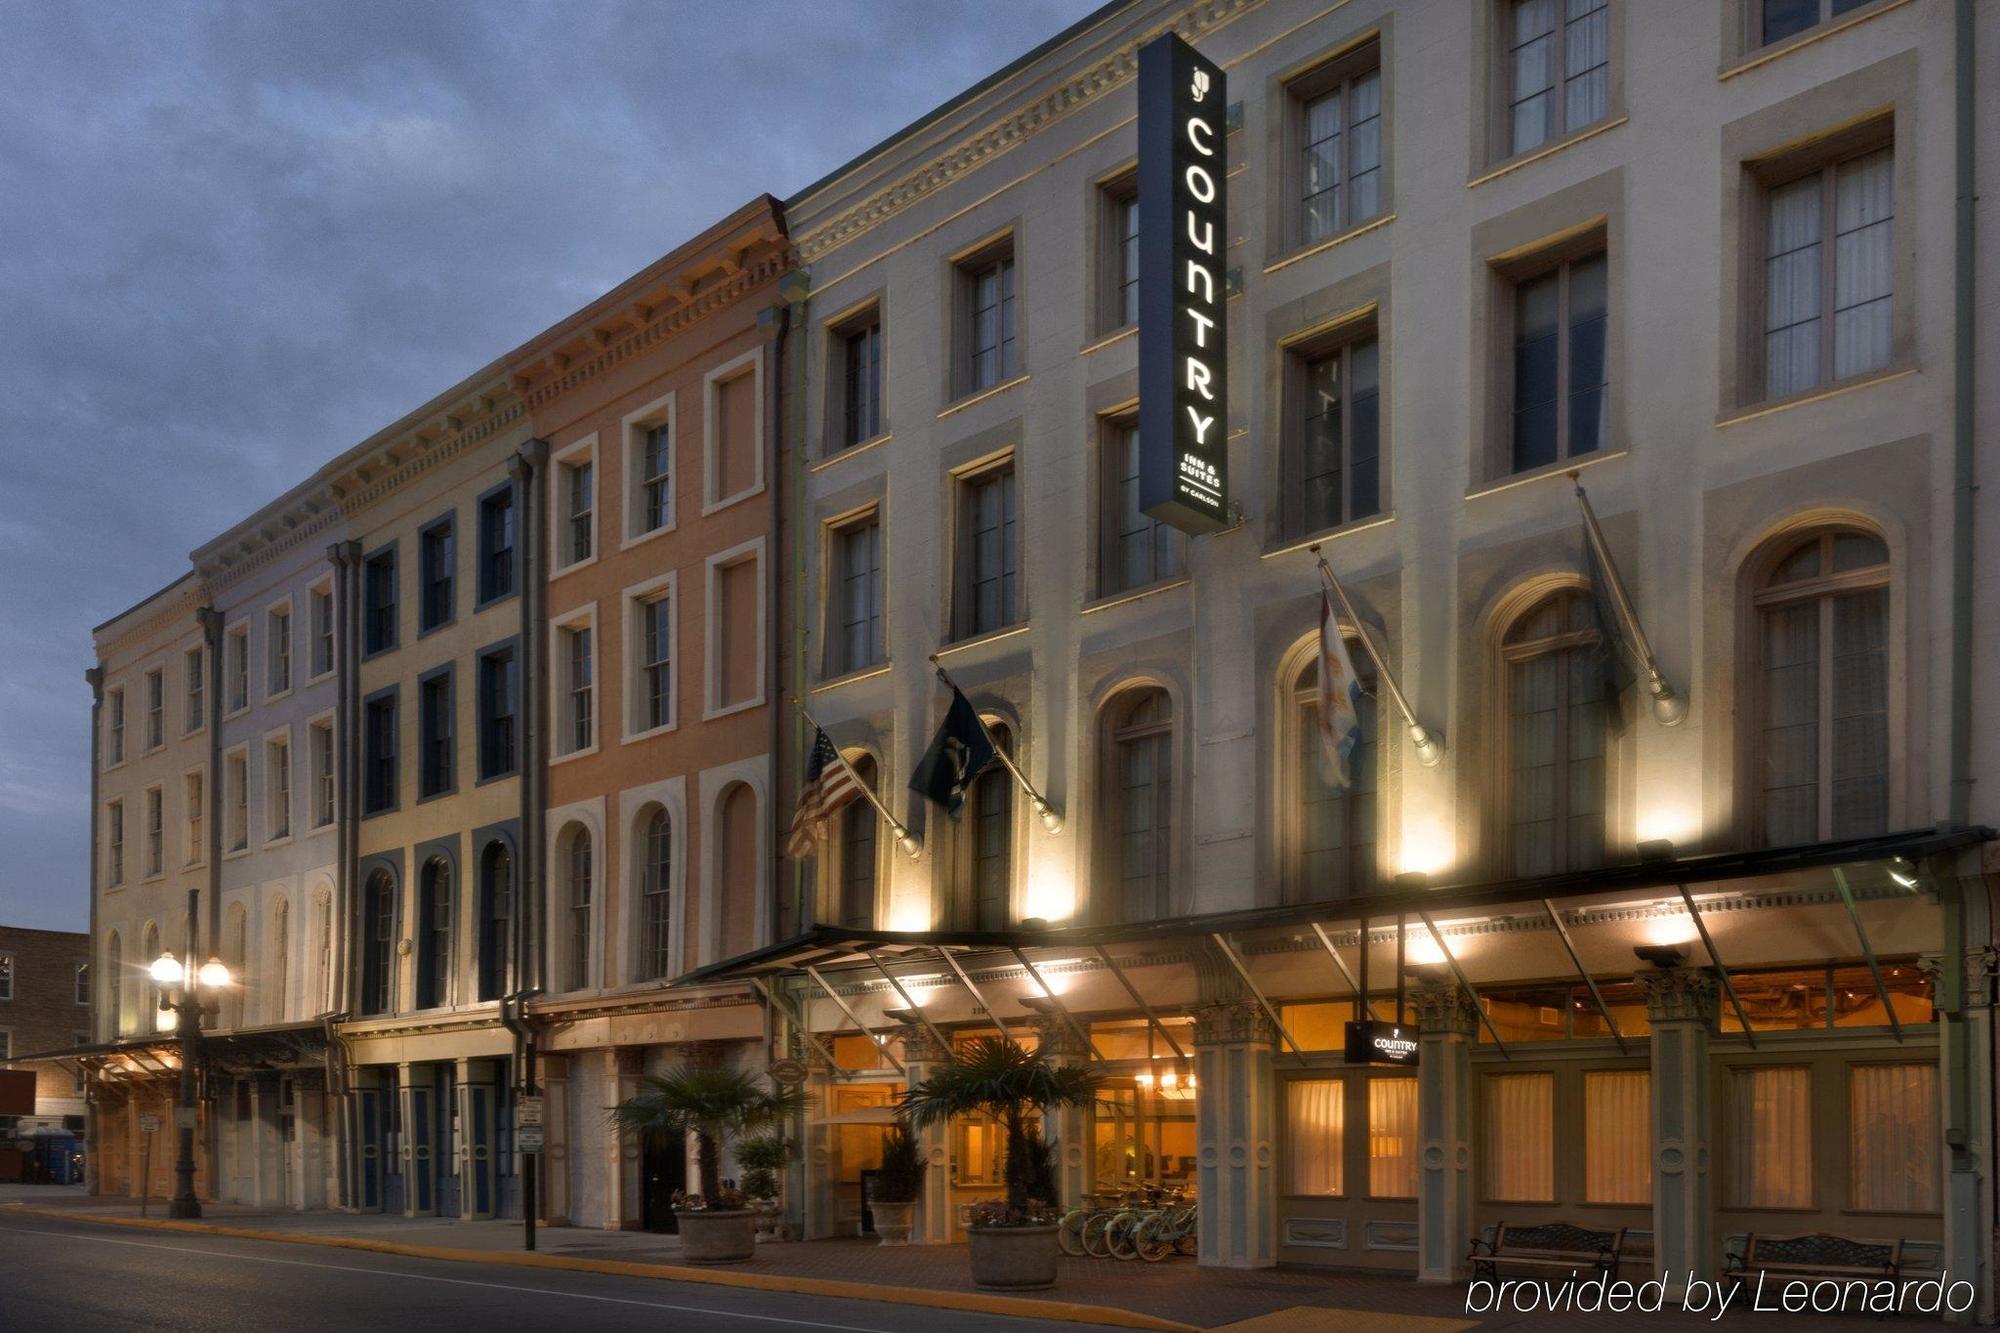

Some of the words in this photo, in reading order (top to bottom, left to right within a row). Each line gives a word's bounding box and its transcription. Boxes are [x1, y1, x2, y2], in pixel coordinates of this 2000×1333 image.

[1180, 462, 1220, 488] SUITES
[1183, 453, 1205, 470] INN
[1207, 465, 1216, 476] &
[1180, 485, 1190, 493] BY
[1190, 489, 1219, 507] CARLSON
